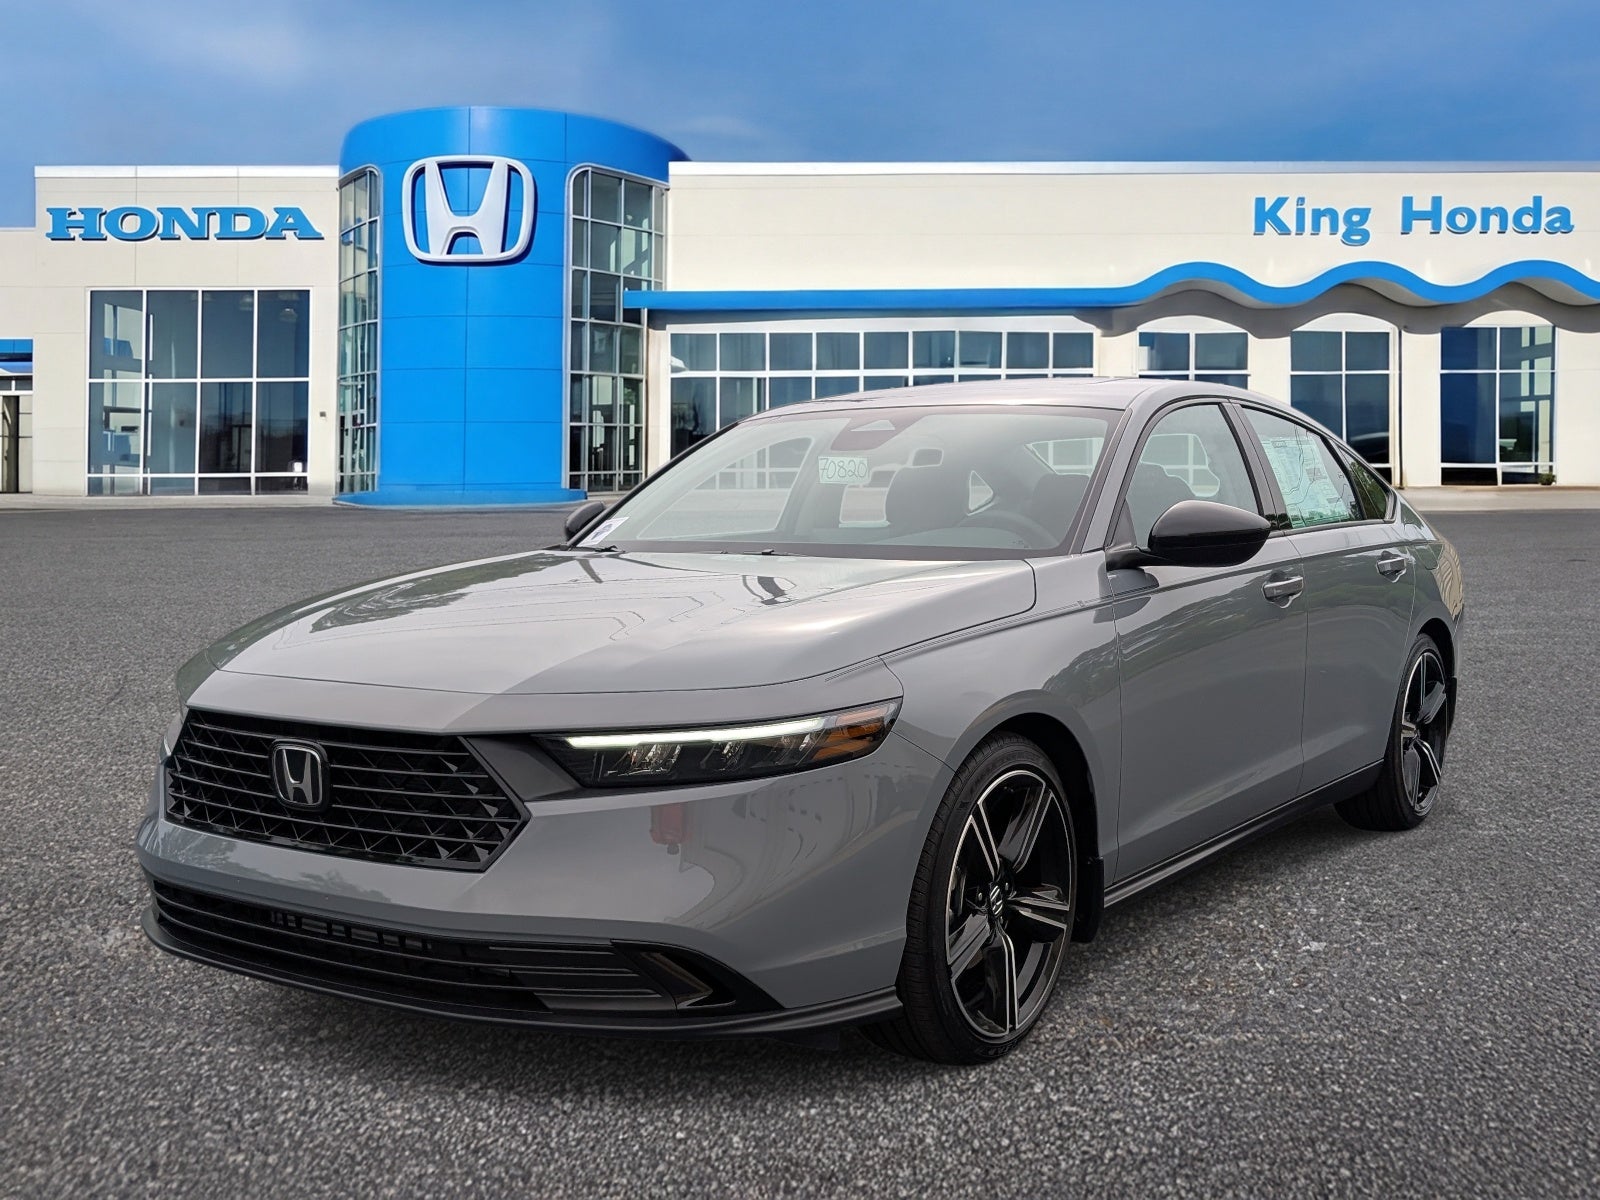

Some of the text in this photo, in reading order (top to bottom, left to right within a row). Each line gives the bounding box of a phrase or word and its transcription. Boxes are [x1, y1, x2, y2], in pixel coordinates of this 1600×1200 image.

[46, 206, 324, 241] HONDA
[1254, 195, 1575, 246] King Honda
[819, 457, 868, 479] 70820
